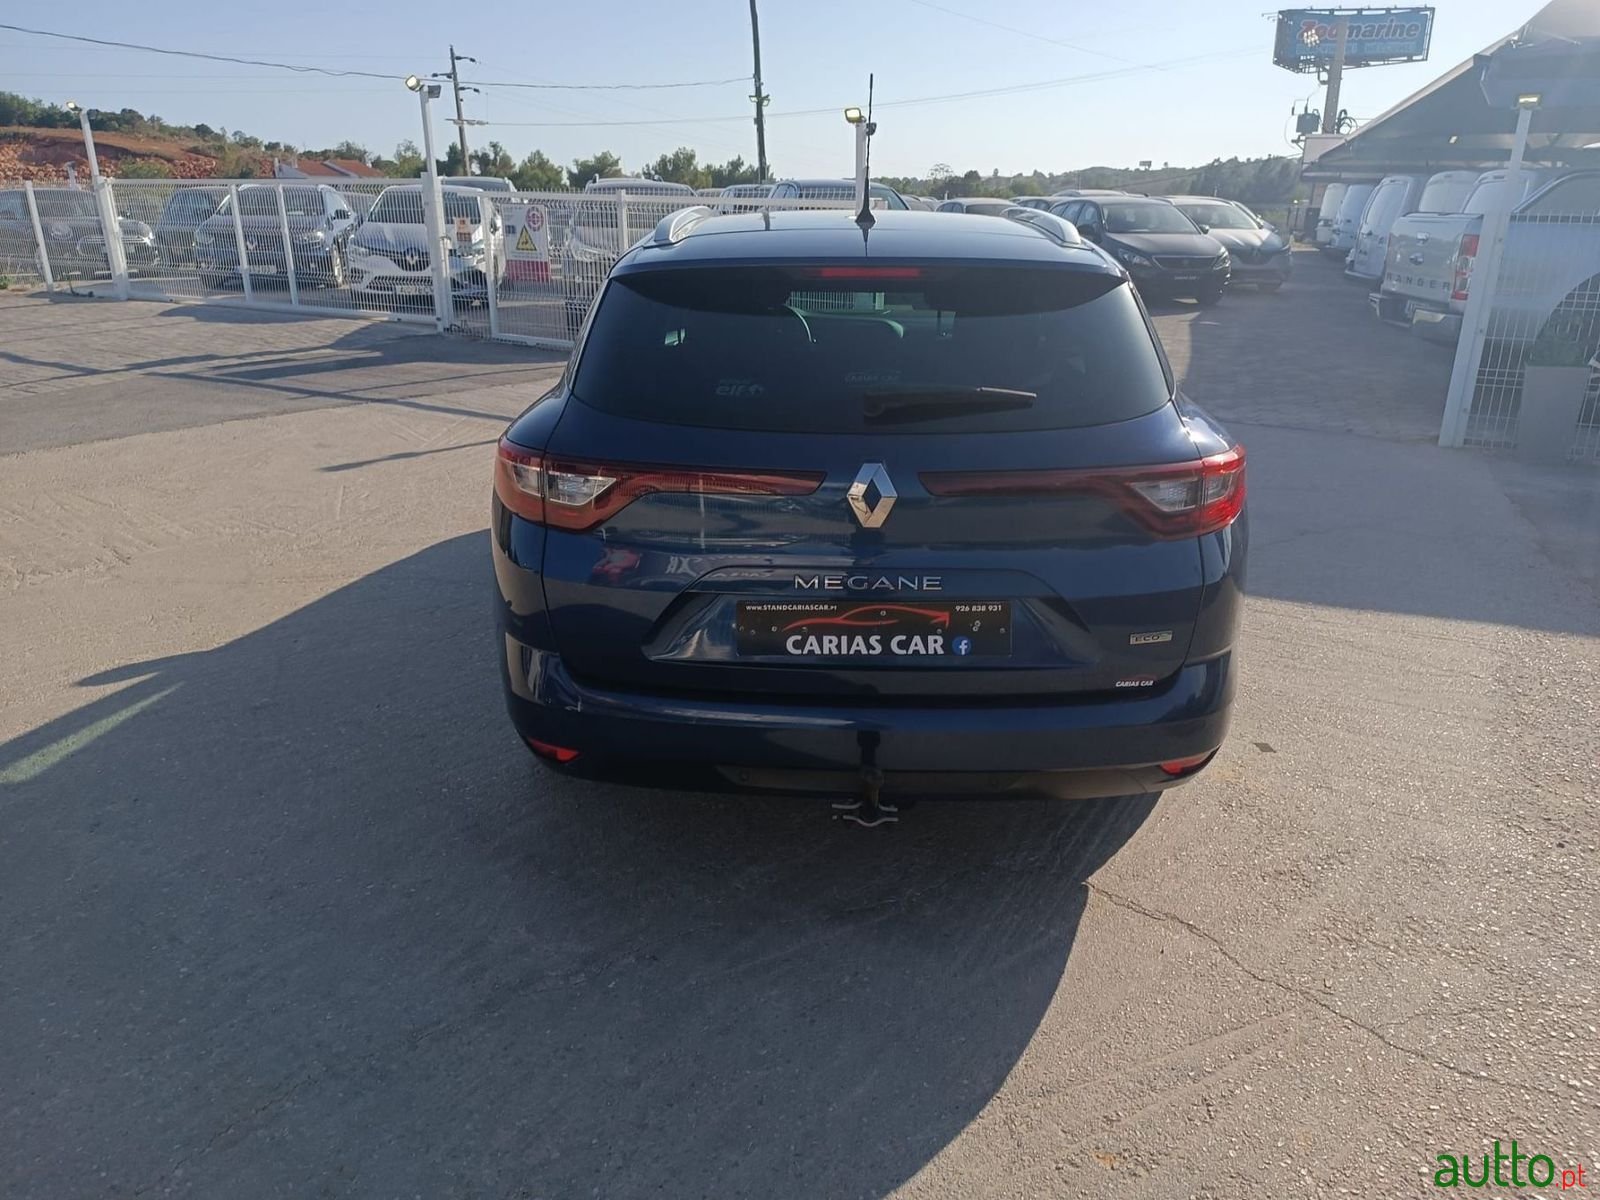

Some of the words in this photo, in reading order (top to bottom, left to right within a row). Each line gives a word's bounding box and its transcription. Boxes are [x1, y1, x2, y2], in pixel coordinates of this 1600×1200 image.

[794, 575, 942, 590] MEGANE
[786, 634, 883, 655] CARIAS
[890, 635, 945, 655] CAR
